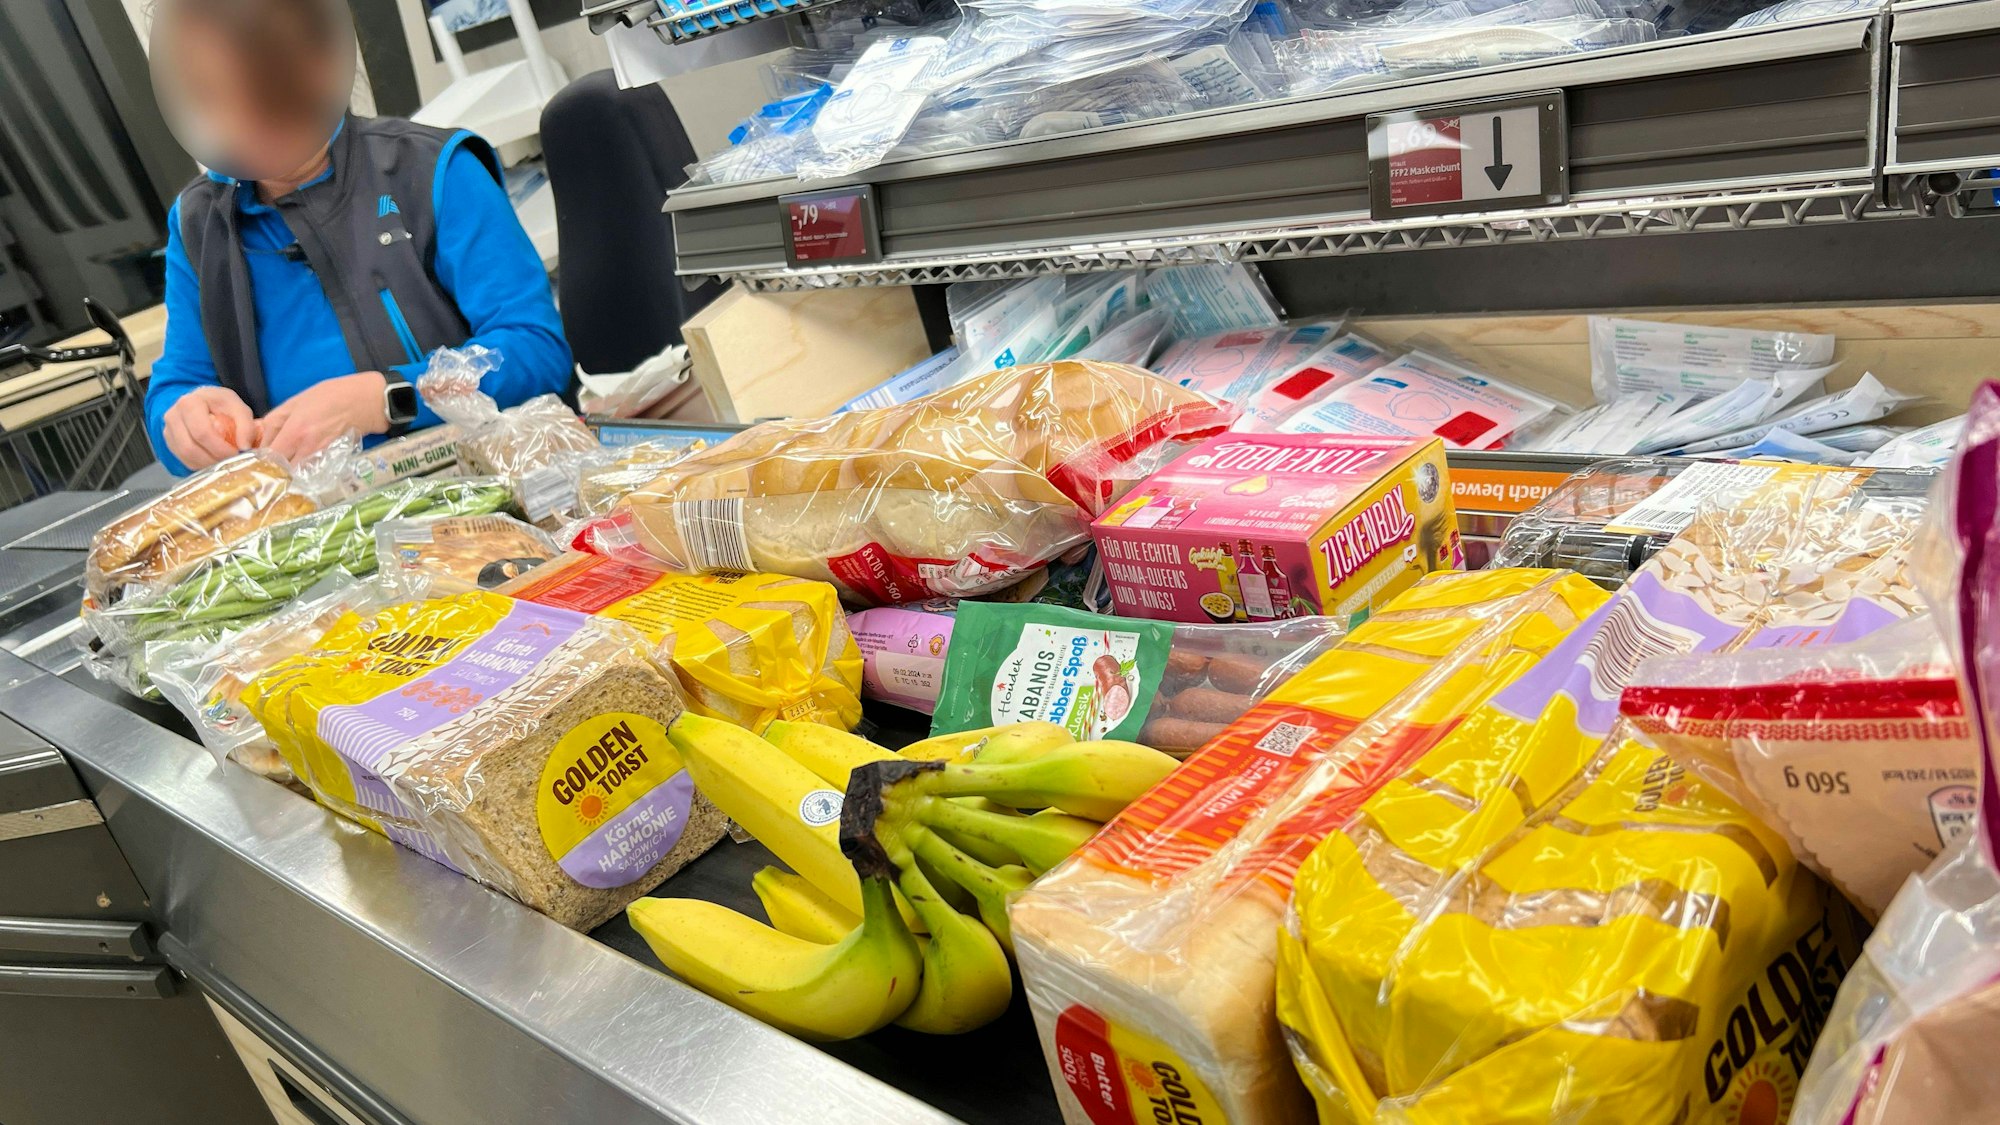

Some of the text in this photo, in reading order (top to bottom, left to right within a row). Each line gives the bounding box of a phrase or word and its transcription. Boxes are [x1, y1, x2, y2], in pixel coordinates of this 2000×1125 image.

[1391, 162, 1461, 178] FFP2 Maskenbunt
[791, 203, 819, 230] -,79
[1213, 441, 1388, 475] ZICKENBOX
[1101, 537, 1182, 565] FÜR DIE ECHTEN
[1320, 484, 1415, 588] ZICKENBOX
[1108, 561, 1188, 590] DRAMA-QUEENS
[1114, 585, 1177, 612] UND -KINGS!
[367, 632, 462, 664] GOLDEN
[460, 650, 535, 675] HARMONIE
[491, 638, 538, 658] Körner
[1063, 635, 1088, 677] Spaß
[374, 658, 430, 677] TOAST
[997, 657, 1024, 718] Houdek
[1017, 650, 1056, 723] ABANOS
[1068, 691, 1091, 737] Klassik
[552, 720, 638, 805] GOLDEN
[597, 744, 649, 795] TOAST
[1239, 758, 1280, 789] SCAN
[1784, 766, 1850, 796] 560 g
[1204, 788, 1245, 818] MICH
[598, 806, 677, 873] HARMONIE
[604, 804, 655, 847] Körner
[617, 830, 667, 874] SANDWICH
[1090, 1052, 1116, 1111] Butter
